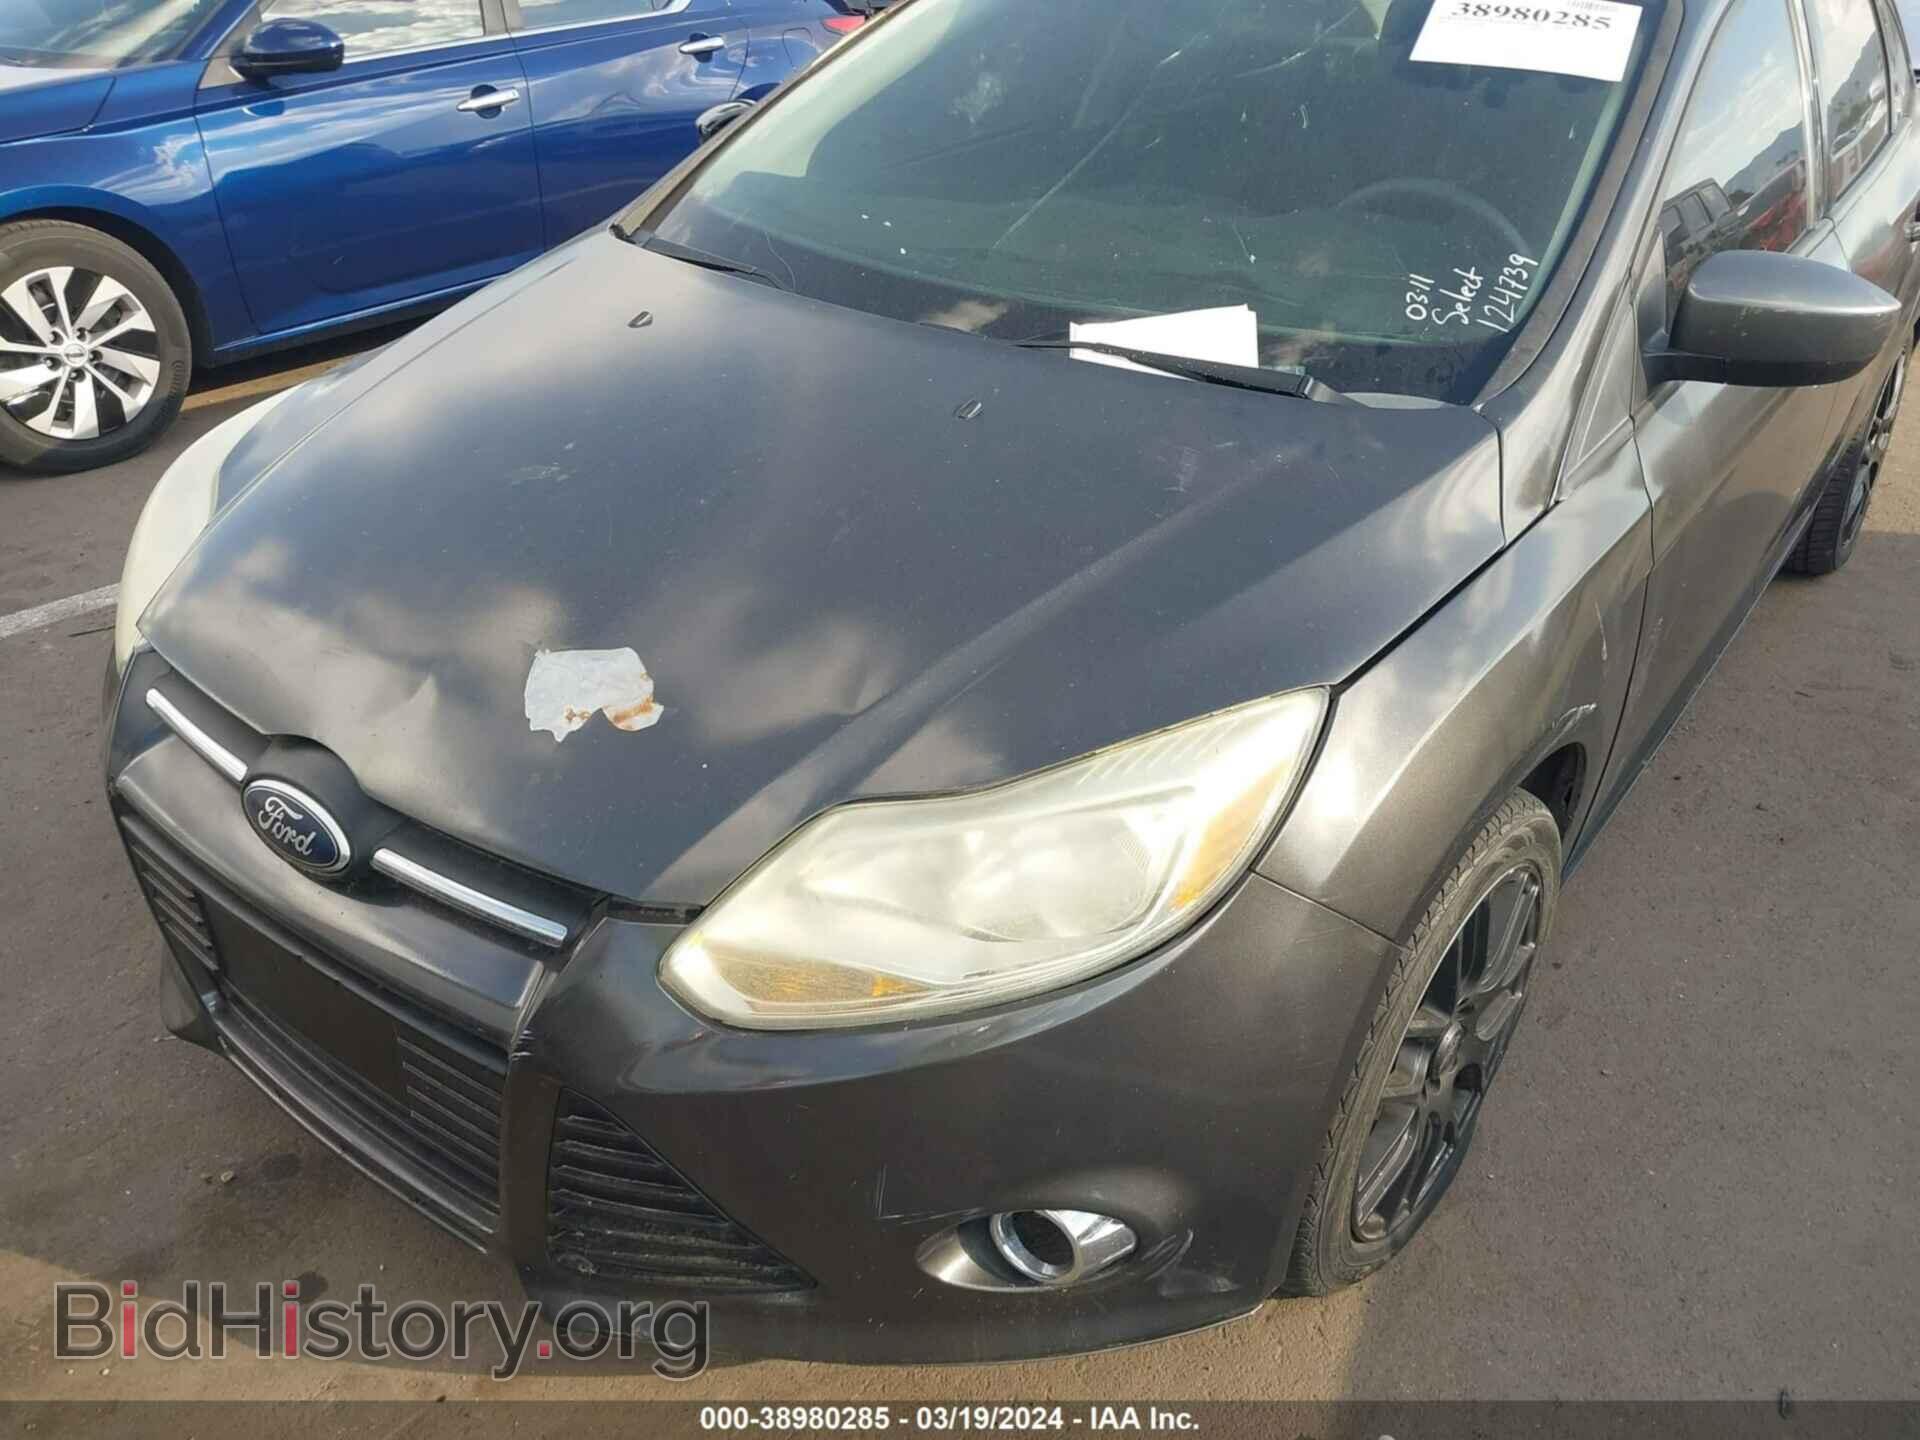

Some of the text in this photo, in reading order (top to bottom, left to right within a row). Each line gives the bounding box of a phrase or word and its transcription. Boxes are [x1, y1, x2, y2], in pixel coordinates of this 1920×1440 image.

[1450, 2, 1612, 30] 38980285
[1476, 253, 1539, 332] 124739
[258, 796, 316, 855] Ford
